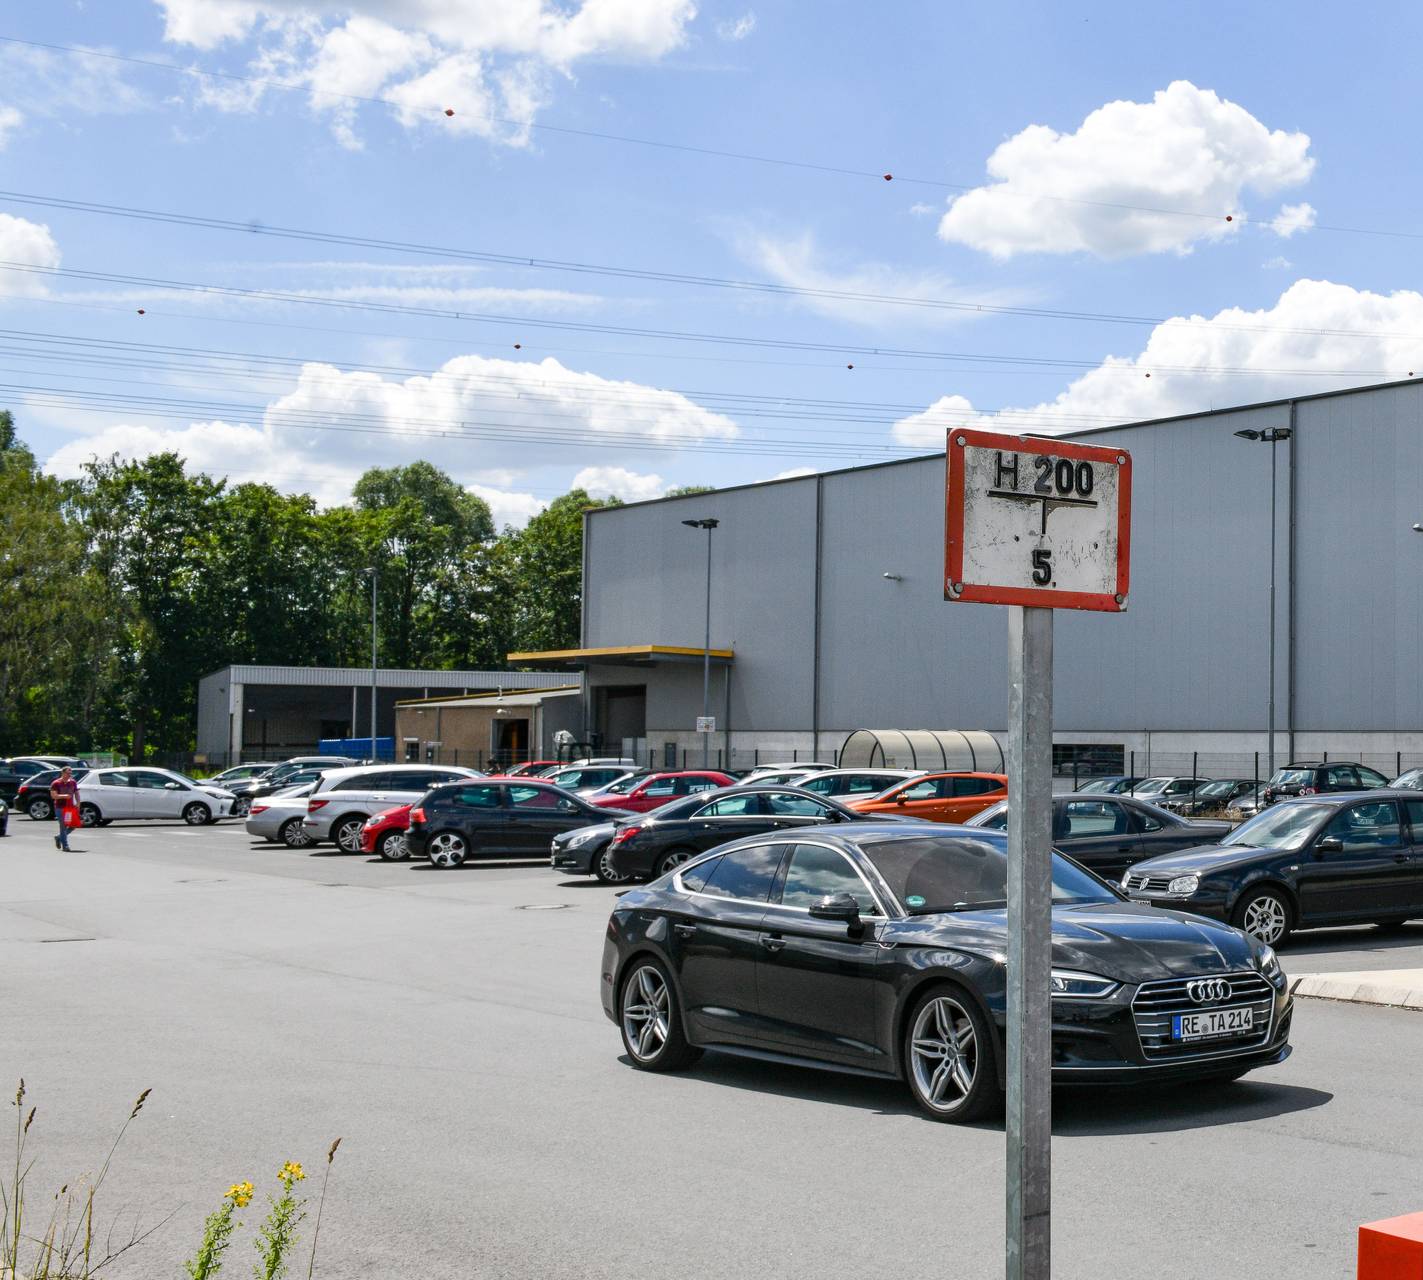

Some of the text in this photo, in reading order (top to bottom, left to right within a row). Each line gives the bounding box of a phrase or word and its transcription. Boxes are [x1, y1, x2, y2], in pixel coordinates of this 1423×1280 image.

[994, 451, 1094, 497] H 200
[1182, 1010, 1251, 1035] RE TA 214
